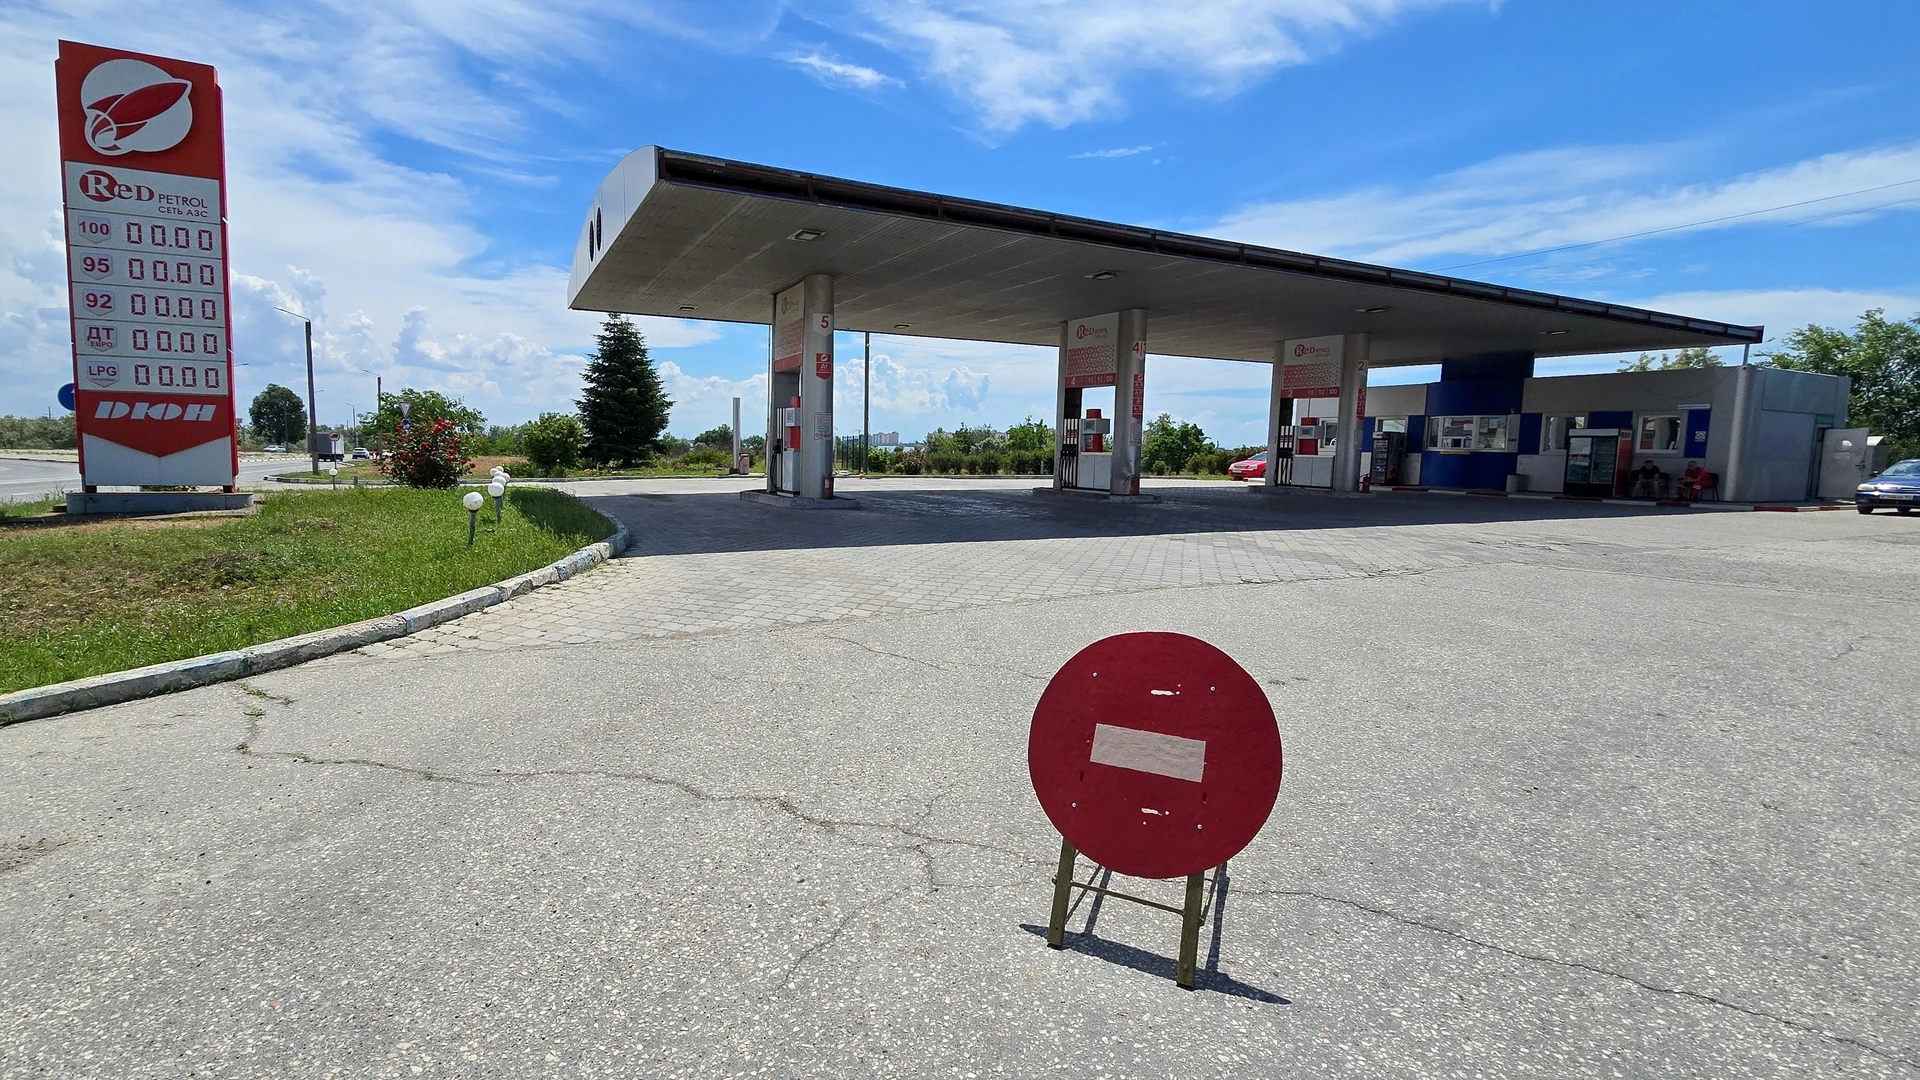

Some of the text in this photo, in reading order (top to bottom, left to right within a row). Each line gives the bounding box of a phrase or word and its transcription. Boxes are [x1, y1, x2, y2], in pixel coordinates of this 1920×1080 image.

[158, 193, 208, 208] PETROL
[158, 206, 208, 218] СЕТЬ АЗС
[79, 220, 110, 236] 100
[82, 256, 110, 273] 95
[85, 292, 112, 309] 92
[820, 315, 829, 329] 5
[87, 326, 115, 341] ДТ
[88, 365, 117, 377] LPG
[1357, 361, 1365, 370] 2
[1070, 376, 1076, 386] 4
[1105, 375, 1114, 383] 100
[1287, 389, 1294, 398] 2
